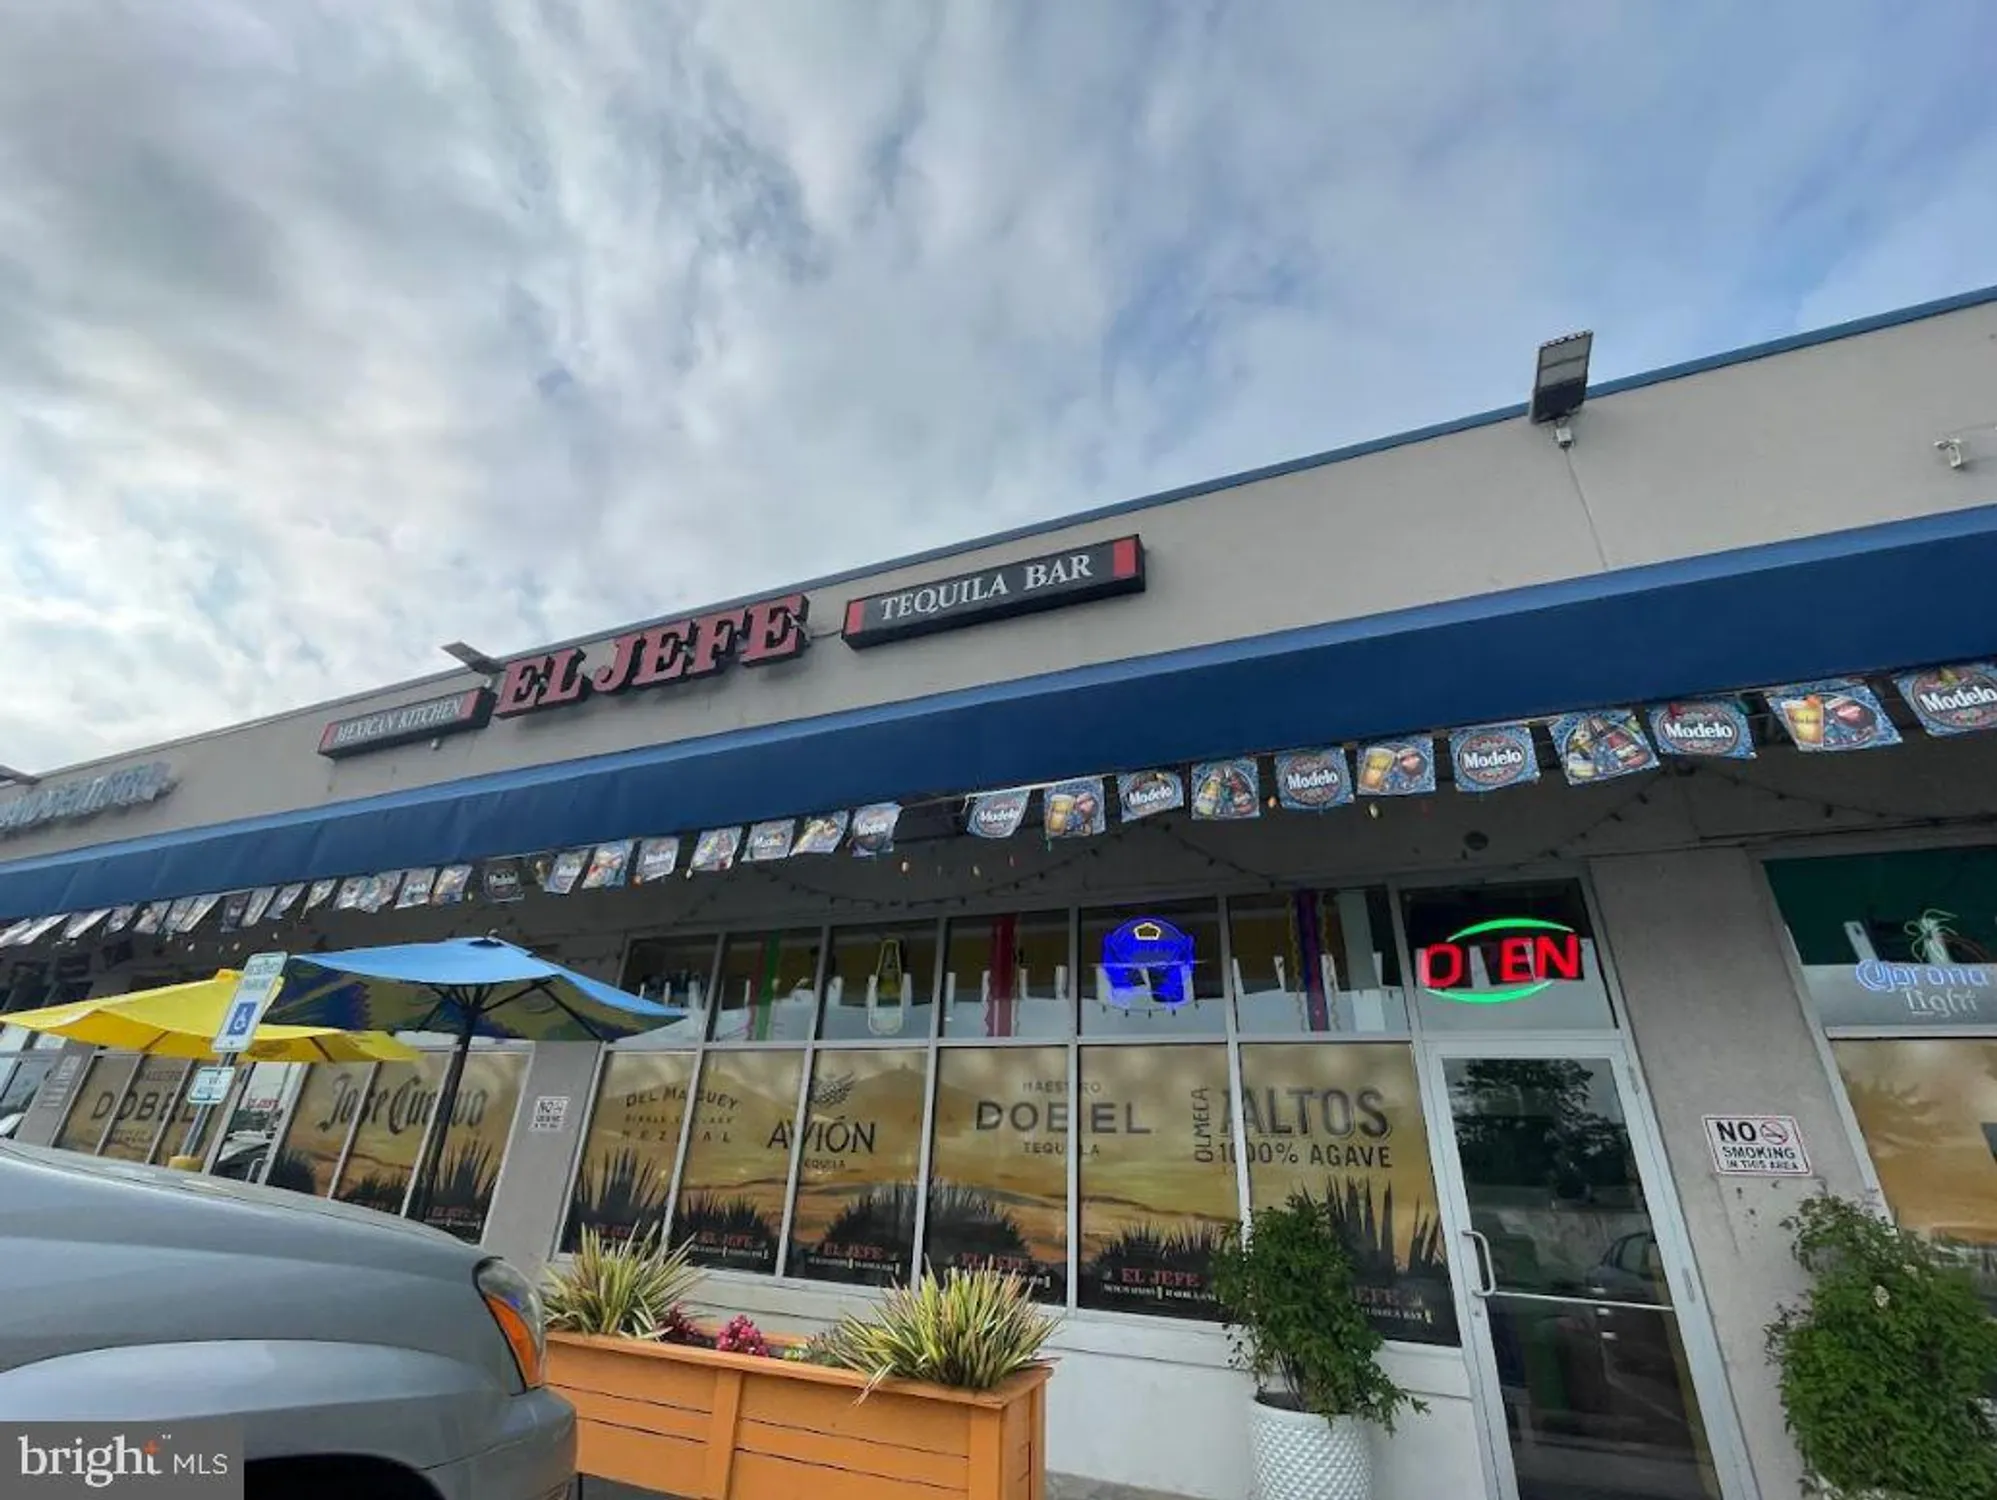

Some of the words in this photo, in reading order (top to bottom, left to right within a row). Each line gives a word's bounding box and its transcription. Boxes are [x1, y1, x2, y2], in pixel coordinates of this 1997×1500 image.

[881, 573, 1009, 621] TEQUILA
[1024, 554, 1094, 590] BAR
[493, 648, 586, 716] EL
[592, 594, 808, 692] JEFE
[1919, 686, 1997, 713] Modelo
[334, 711, 397, 744] MEXICAN
[398, 696, 464, 730] KITCHEN
[1663, 722, 1733, 738] Modelo
[1462, 750, 1523, 769] Modelo
[1286, 771, 1339, 791] Modelo
[1128, 786, 1173, 804] Modelo
[979, 805, 1021, 822] Modelo
[1420, 933, 1580, 988] OEN
[1855, 959, 1990, 992] Corona
[626, 1091, 658, 1107] DEL
[1716, 1121, 1757, 1142] NO
[1310, 1143, 1394, 1168] AGAVE
[1722, 1145, 1796, 1159] SMOKING
[1121, 1268, 1145, 1284] EL
